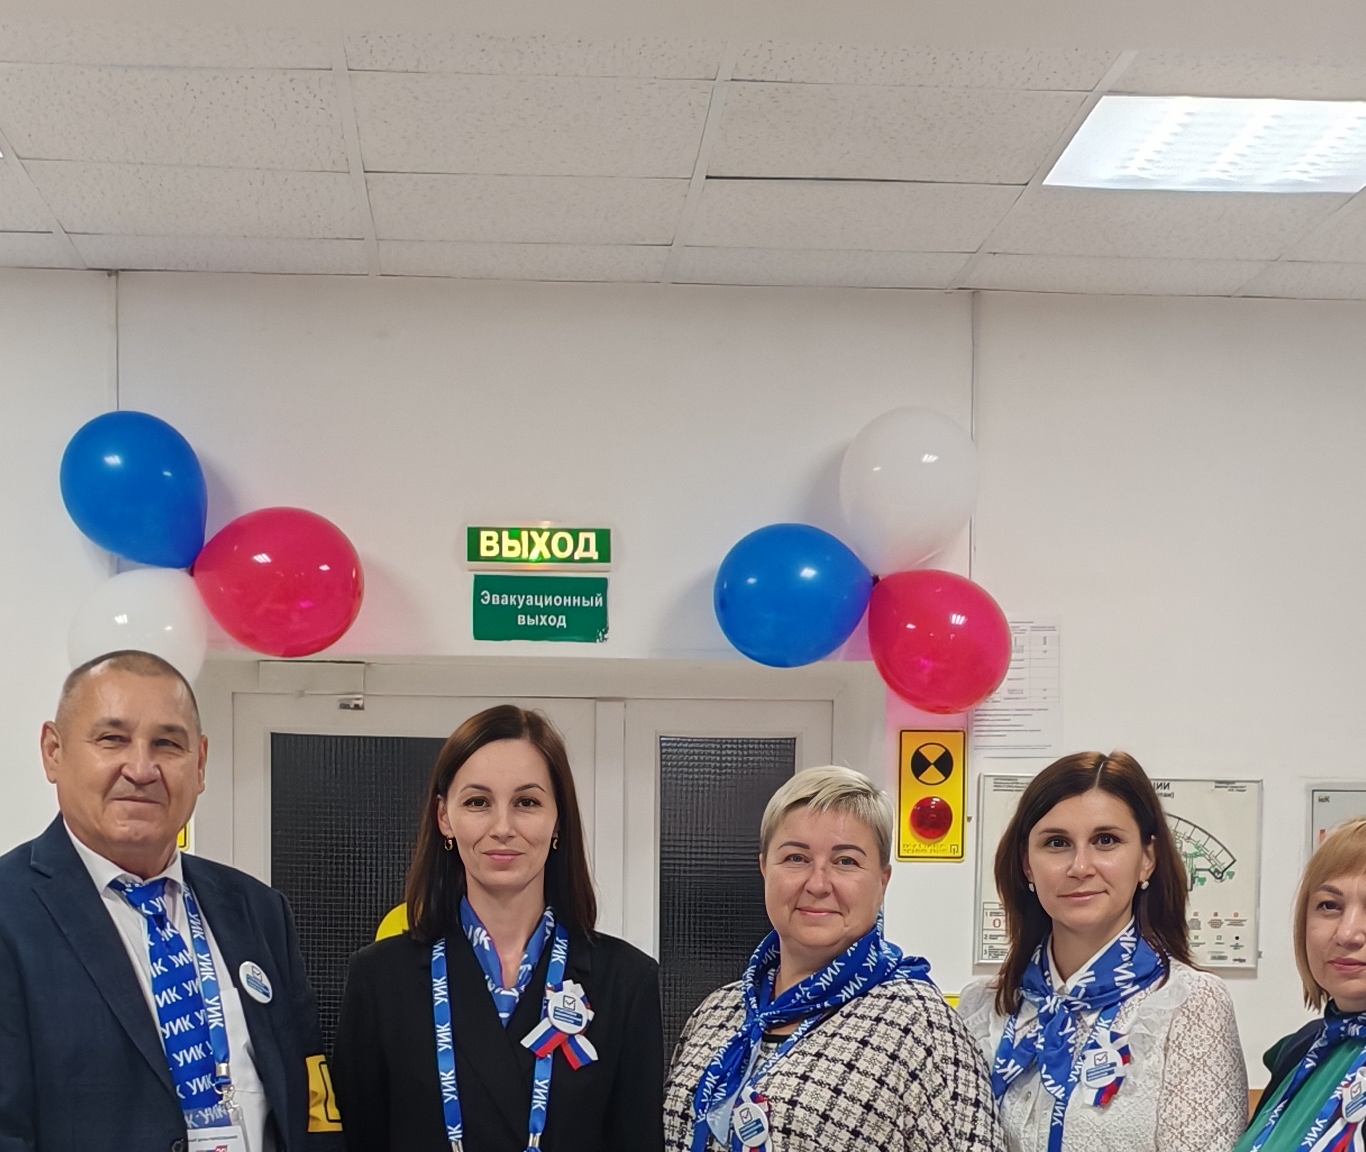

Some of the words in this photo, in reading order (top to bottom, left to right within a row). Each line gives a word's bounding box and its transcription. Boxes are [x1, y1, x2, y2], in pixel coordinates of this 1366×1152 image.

[480, 530, 598, 560] ВЫХОД
[480, 590, 603, 609] Эвакуационный
[517, 614, 567, 628] выход
[188, 912, 206, 941] УИК
[551, 936, 569, 965] УИК
[197, 952, 217, 982] УИК
[815, 959, 846, 991] УИК
[434, 976, 448, 1006] УИК
[836, 973, 868, 1003] УИК
[160, 1015, 196, 1039] УИК
[204, 995, 225, 1030] УИК
[438, 1022, 452, 1052] УИК
[172, 1043, 206, 1068] УИК
[186, 1073, 214, 1097] УИК
[441, 1069, 457, 1104] УИК
[532, 1079, 550, 1111] УИК
[701, 1071, 720, 1103] УИК
[1301, 1118, 1329, 1148] УИК
